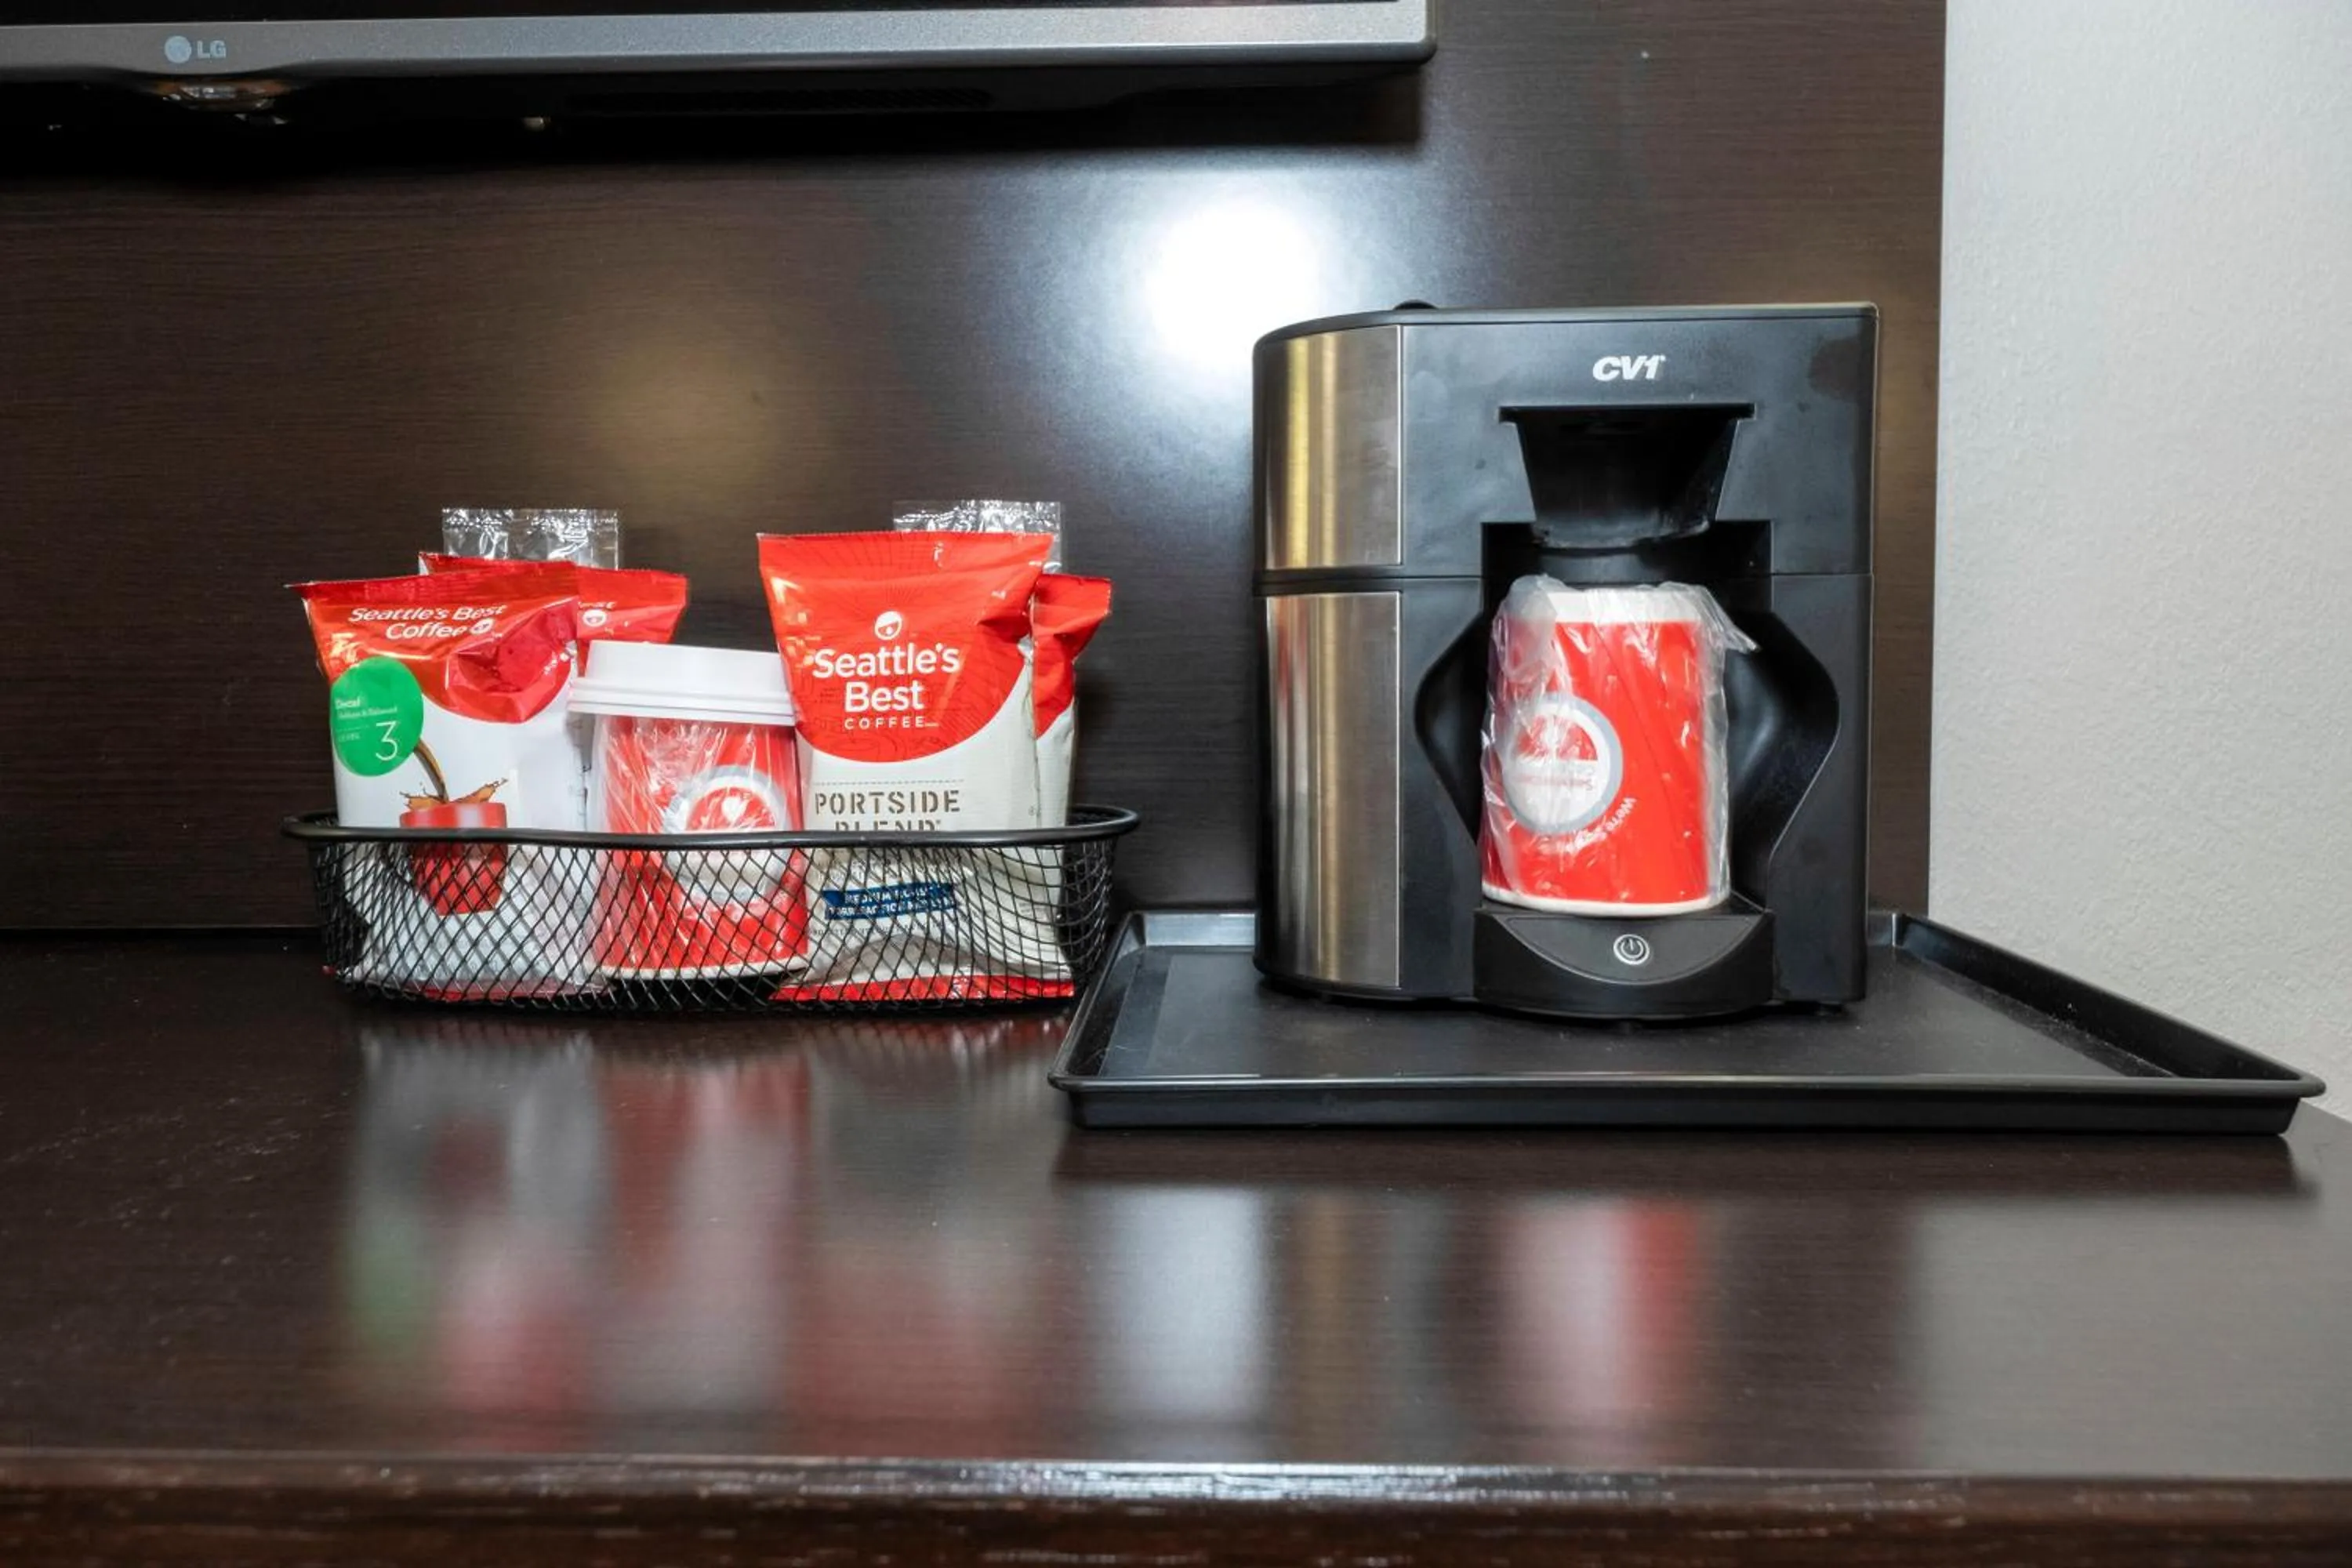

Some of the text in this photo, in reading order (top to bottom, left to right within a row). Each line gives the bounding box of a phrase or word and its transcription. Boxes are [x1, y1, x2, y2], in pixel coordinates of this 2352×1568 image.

[197, 40, 227, 59] LG
[348, 606, 507, 622] Seattle's Best
[385, 622, 468, 640] Coffee
[812, 643, 960, 678] Seattle's
[844, 680, 925, 713] Best
[844, 716, 925, 730] COFFEE
[376, 720, 397, 761] 3
[815, 790, 960, 815] PORTSIDE
